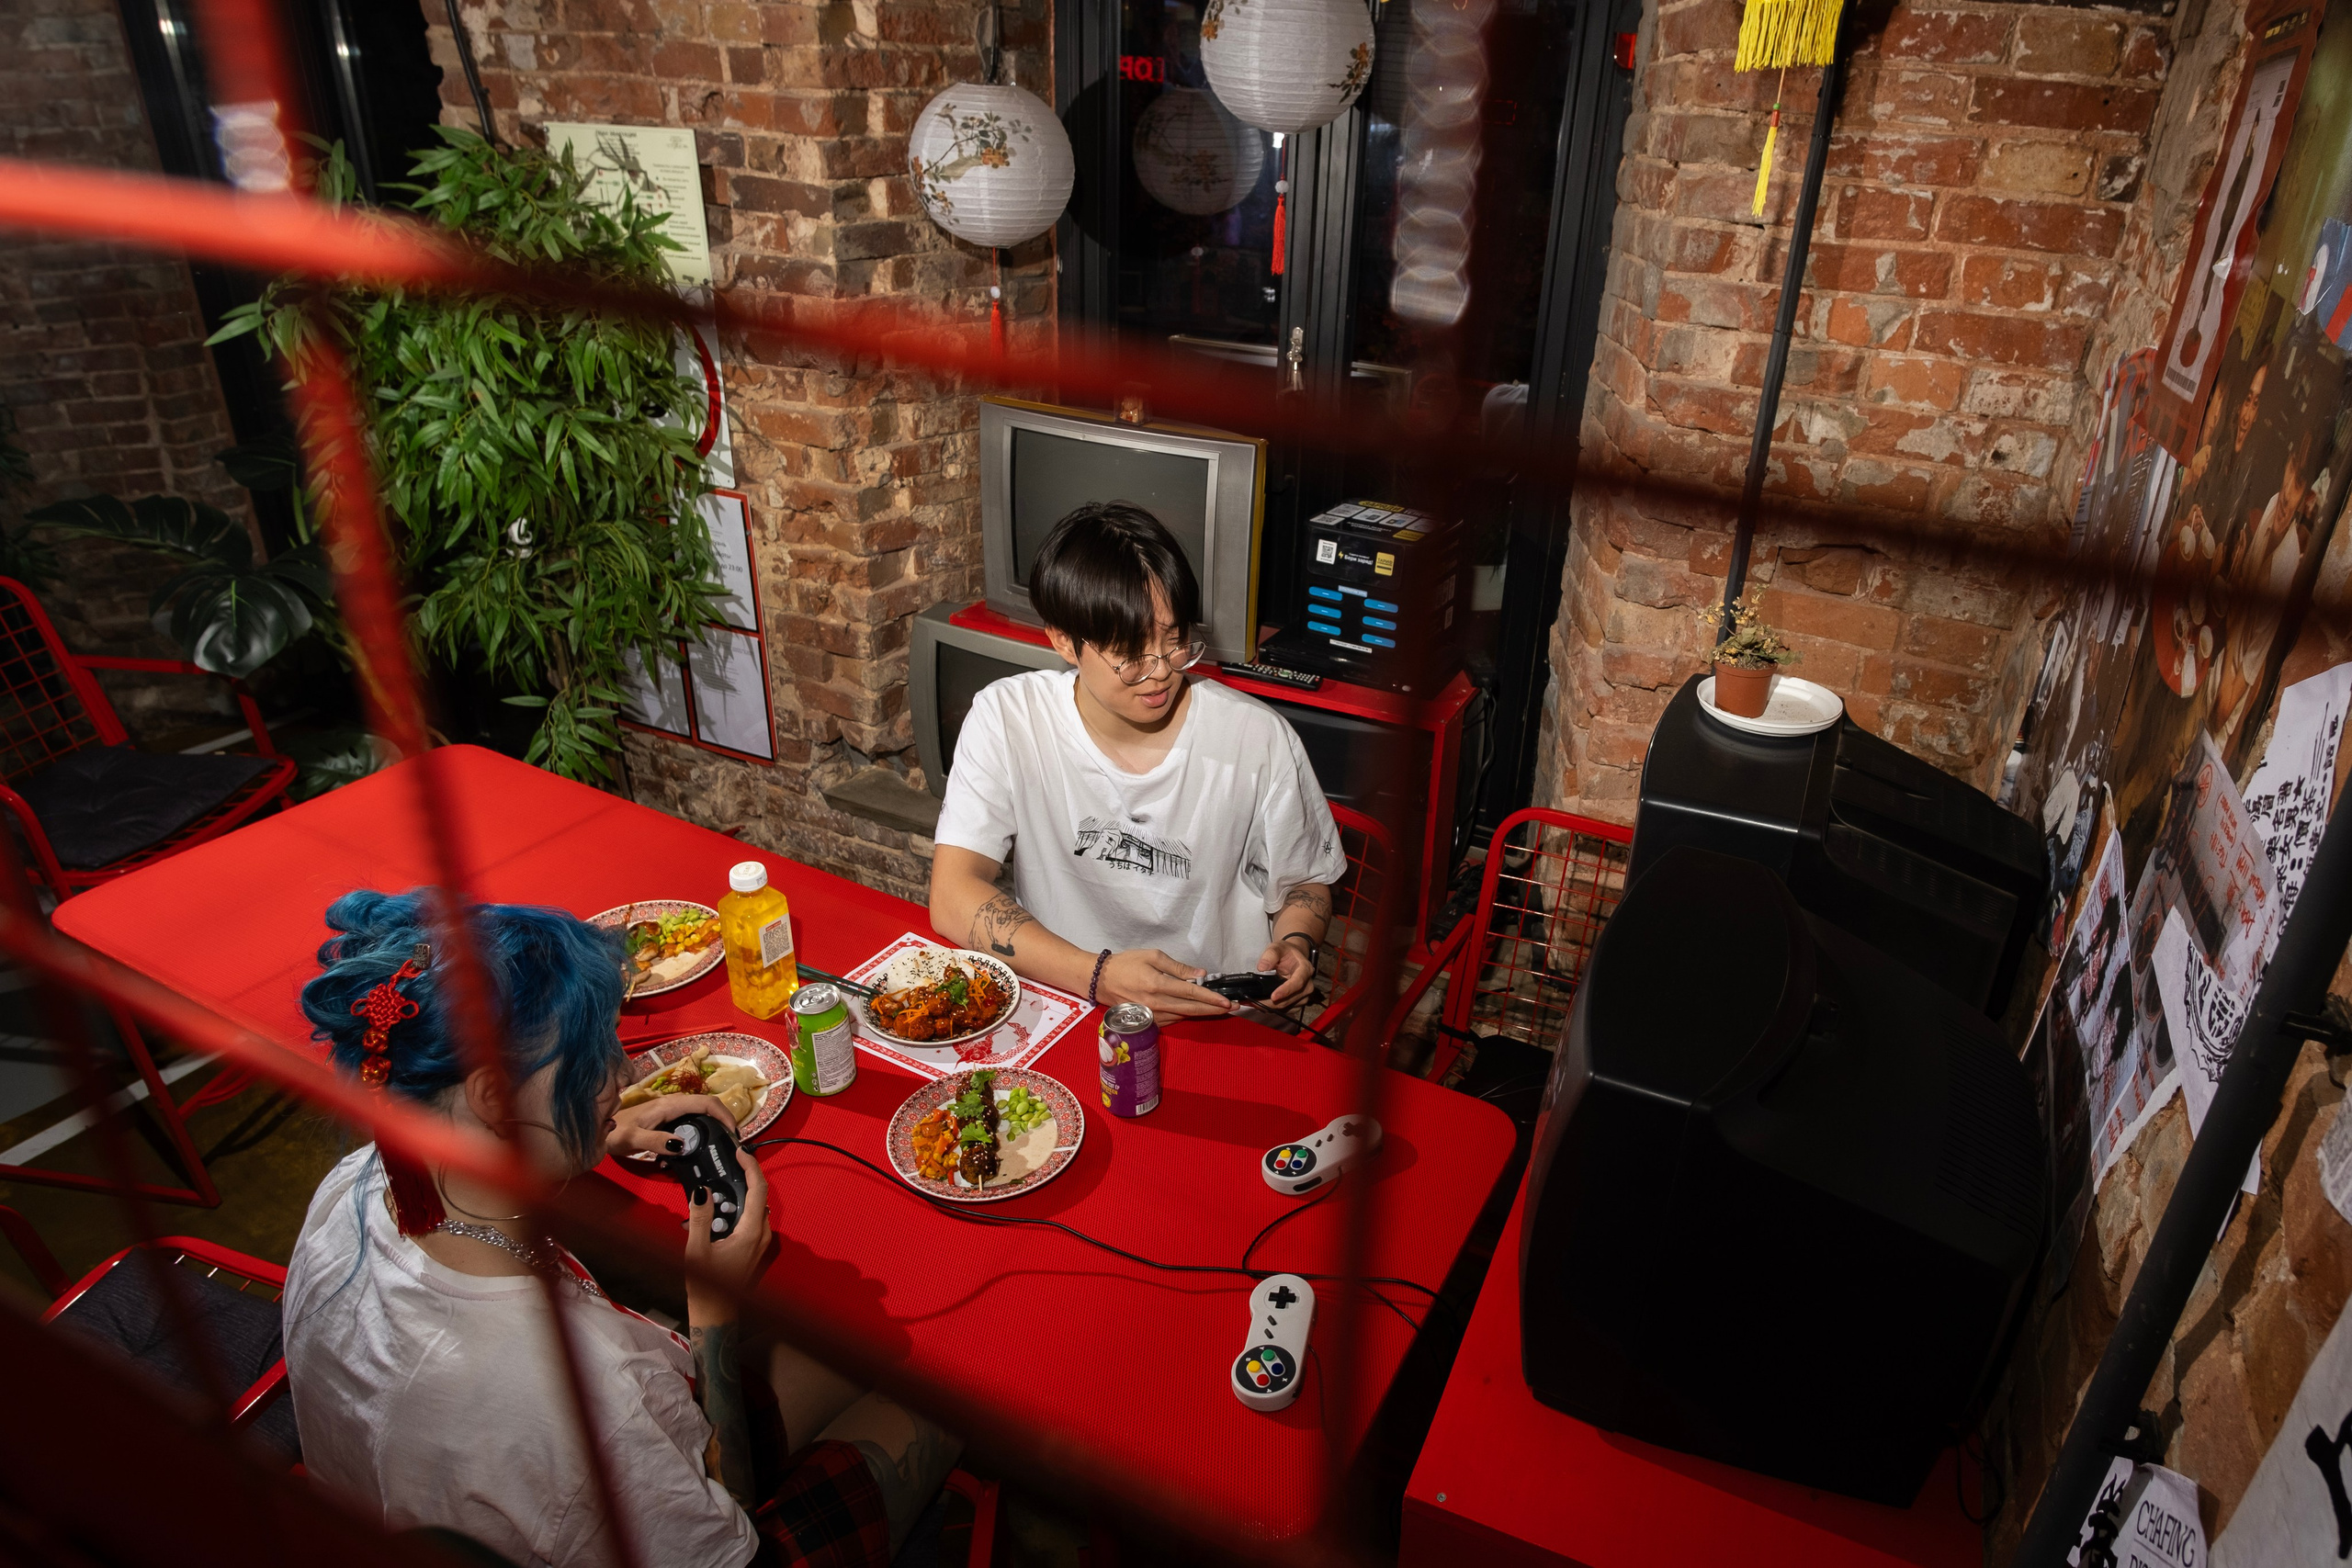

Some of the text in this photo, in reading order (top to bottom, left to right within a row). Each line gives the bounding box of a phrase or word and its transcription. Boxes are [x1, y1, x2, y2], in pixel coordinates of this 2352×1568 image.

[1109, 861, 1155, 875] うちは イタチ
[2136, 1499, 2197, 1568] CHAFING
